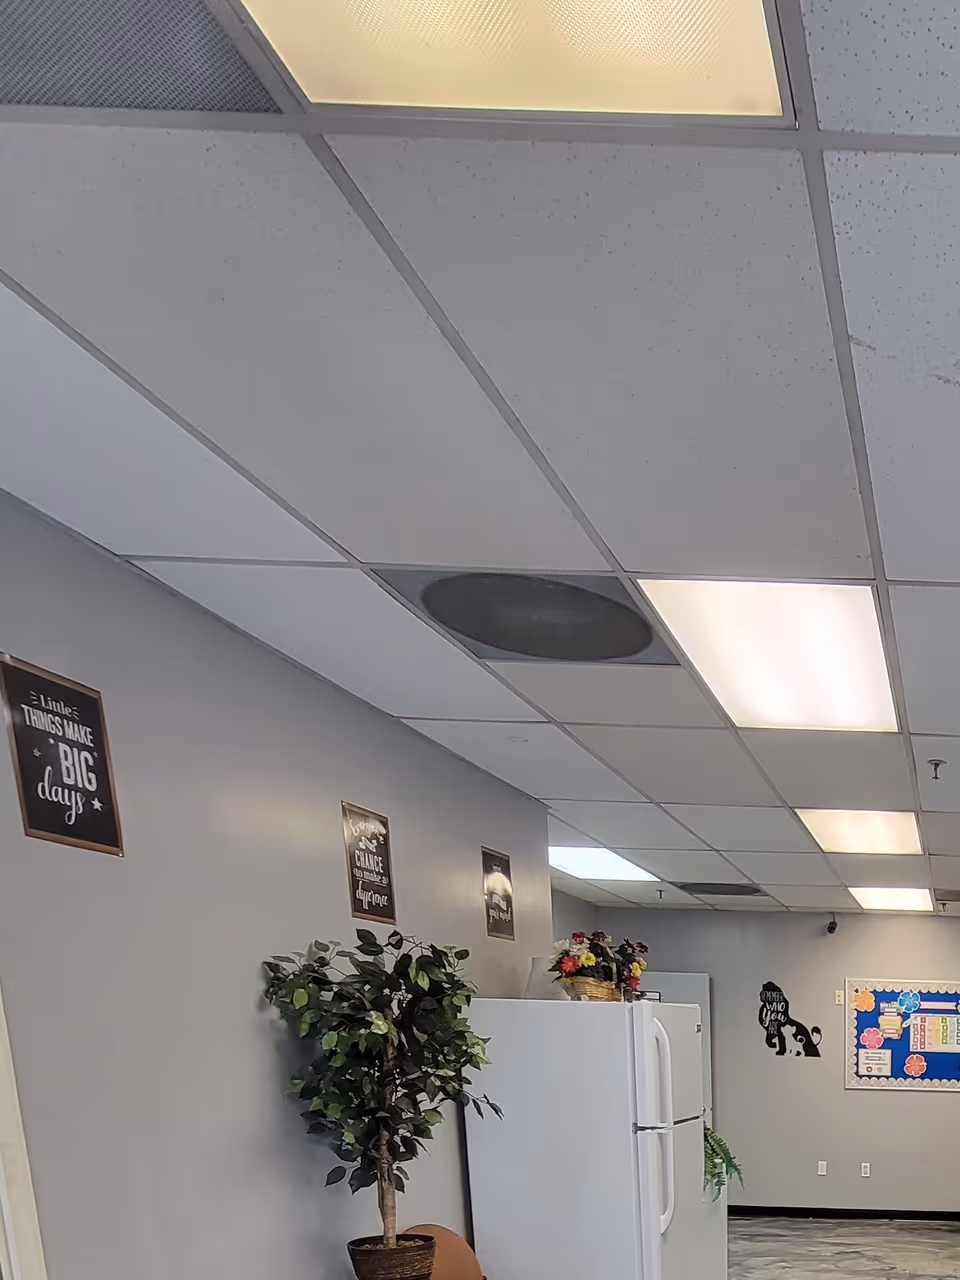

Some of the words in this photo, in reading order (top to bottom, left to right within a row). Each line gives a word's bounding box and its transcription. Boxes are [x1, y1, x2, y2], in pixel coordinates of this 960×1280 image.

[40, 694, 72, 717] Little
[21, 704, 63, 735] THINGS
[64, 720, 94, 747] MAKE
[58, 741, 97, 792] BIG
[37, 765, 85, 825] days
[354, 849, 384, 873] CHANCE
[762, 1007, 787, 1027] You
[766, 1002, 785, 1012] WHO
[768, 1021, 778, 1034] ARE
